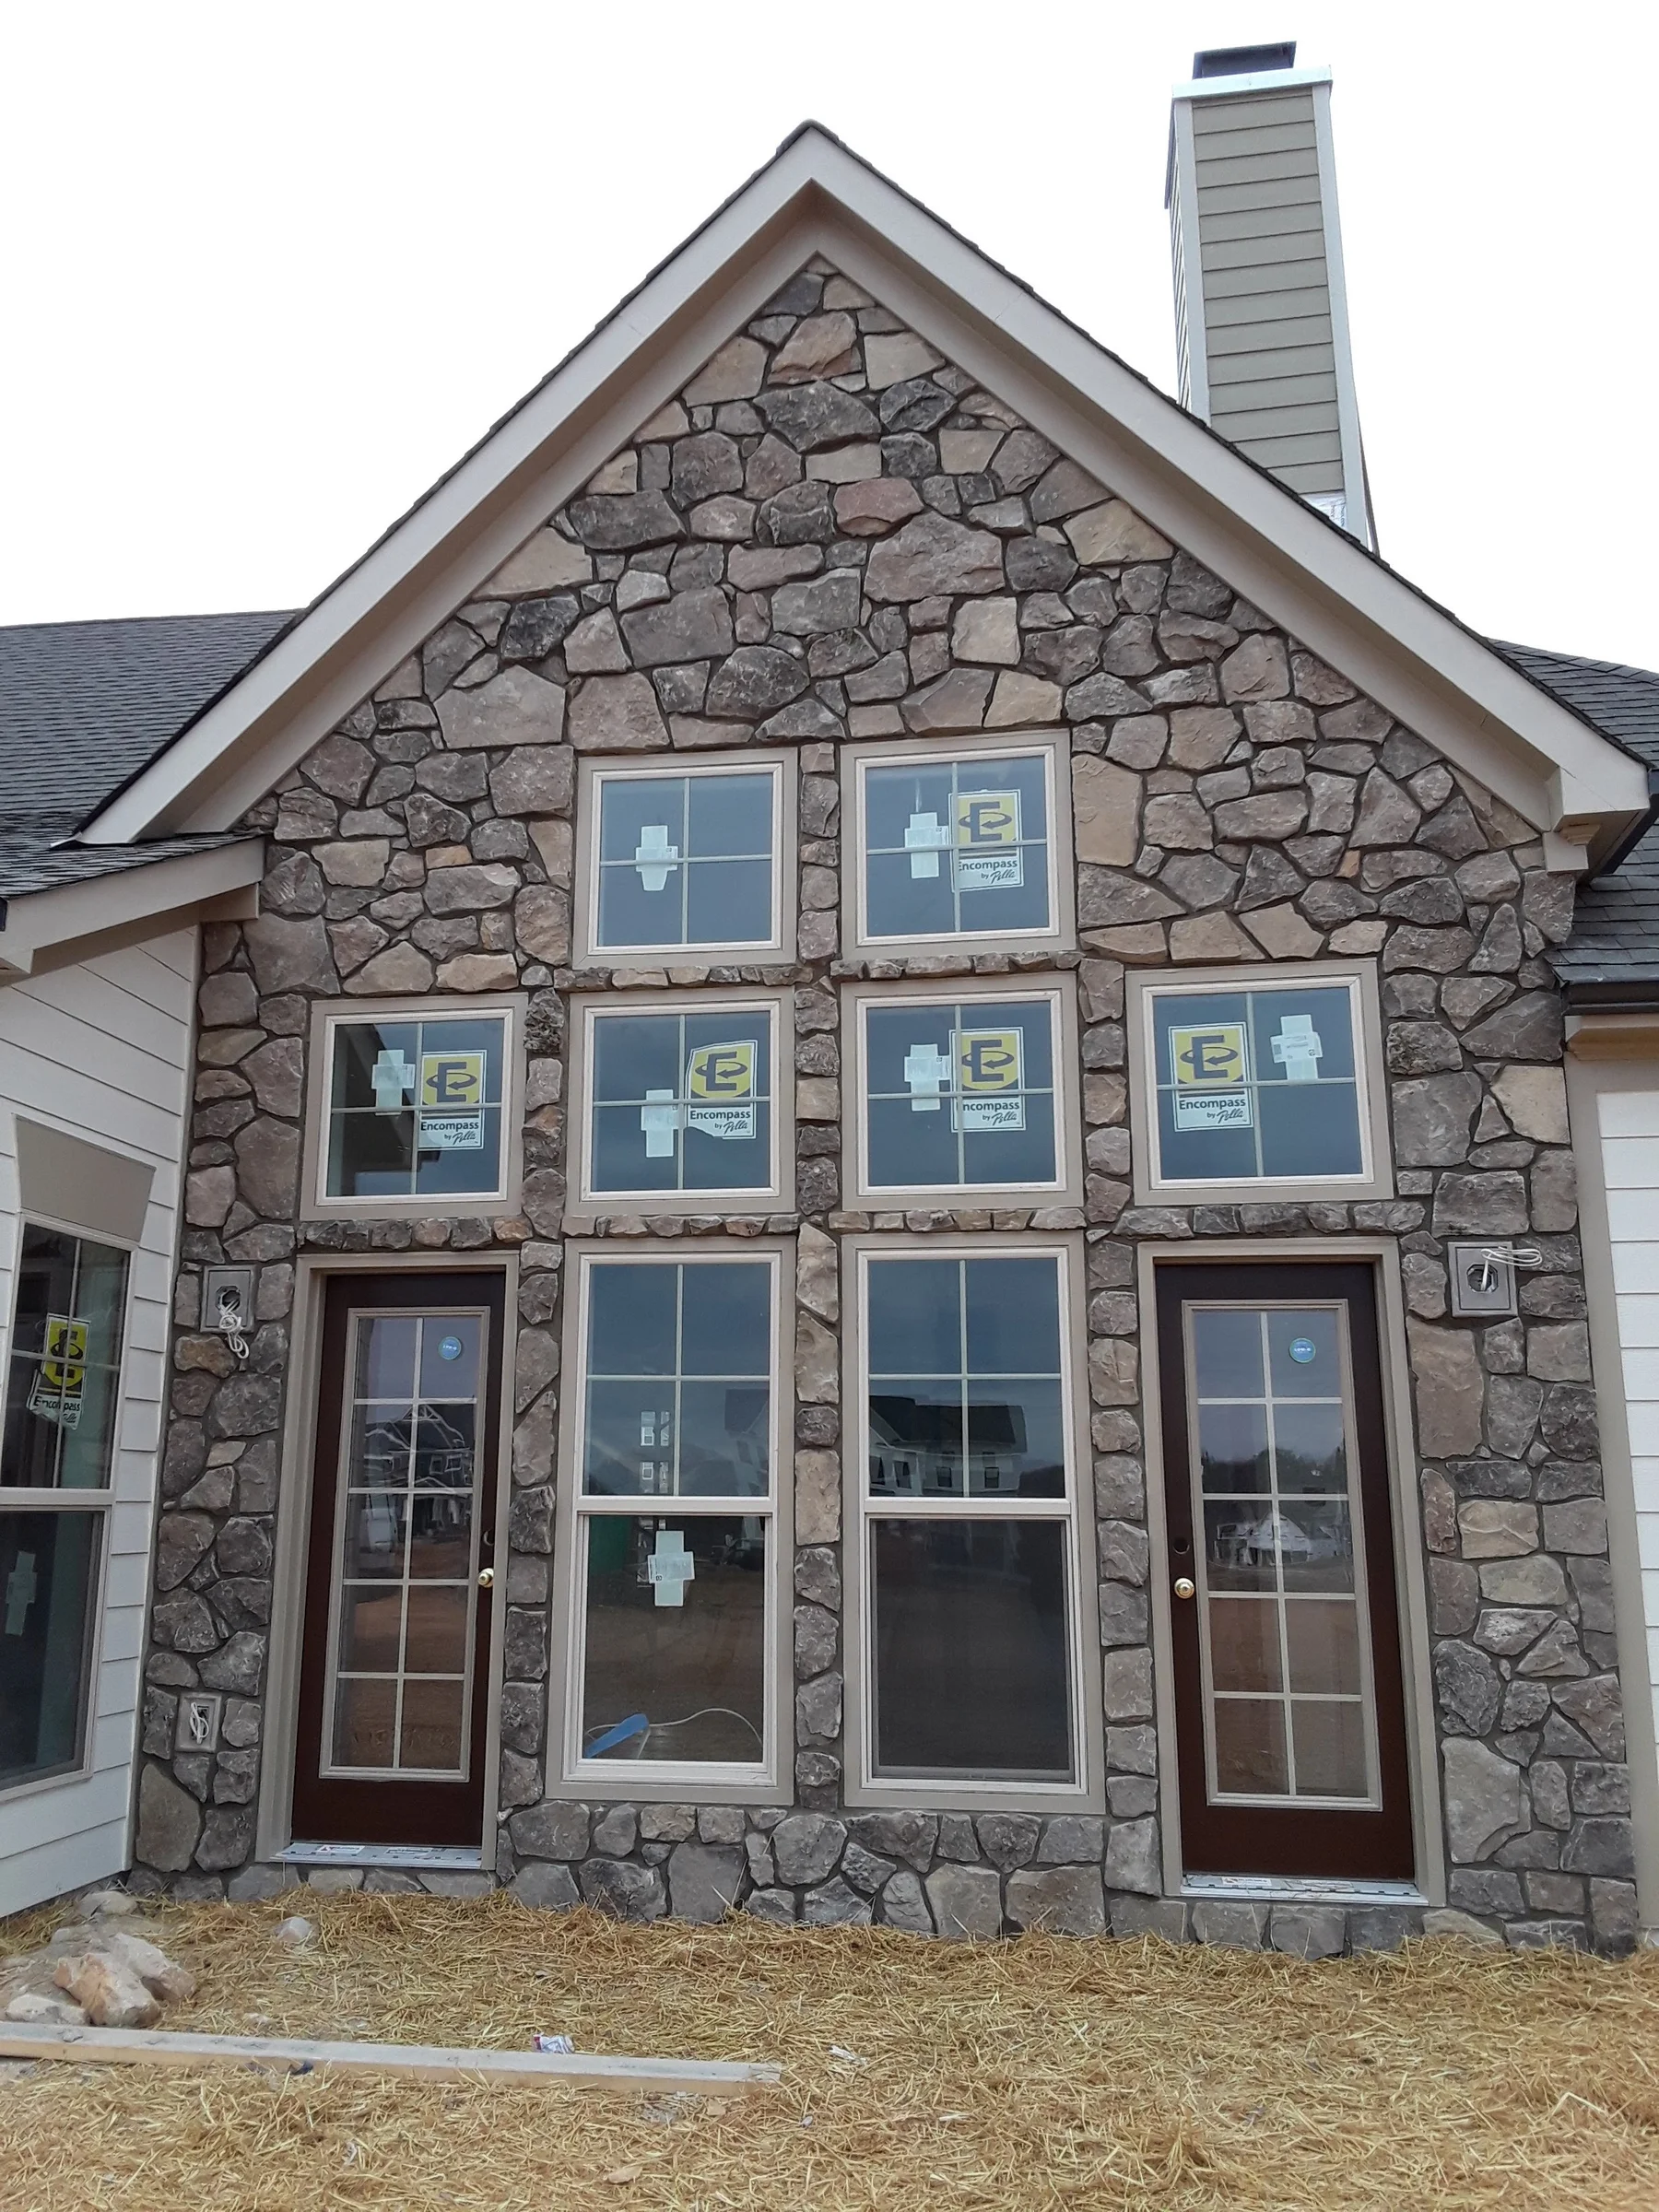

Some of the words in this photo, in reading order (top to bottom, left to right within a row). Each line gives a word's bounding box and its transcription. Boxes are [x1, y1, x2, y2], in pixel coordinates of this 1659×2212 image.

[990, 869, 1016, 884] Pella
[962, 1101, 1020, 1112] ncompass
[1179, 1099, 1246, 1110] Encompass
[690, 1110, 751, 1121] Encompass
[991, 1112, 1018, 1126] Pella
[1216, 1108, 1243, 1124] Pella
[420, 1122, 479, 1132] Encompass
[723, 1120, 748, 1135] Pella
[452, 1131, 476, 1146] Pella
